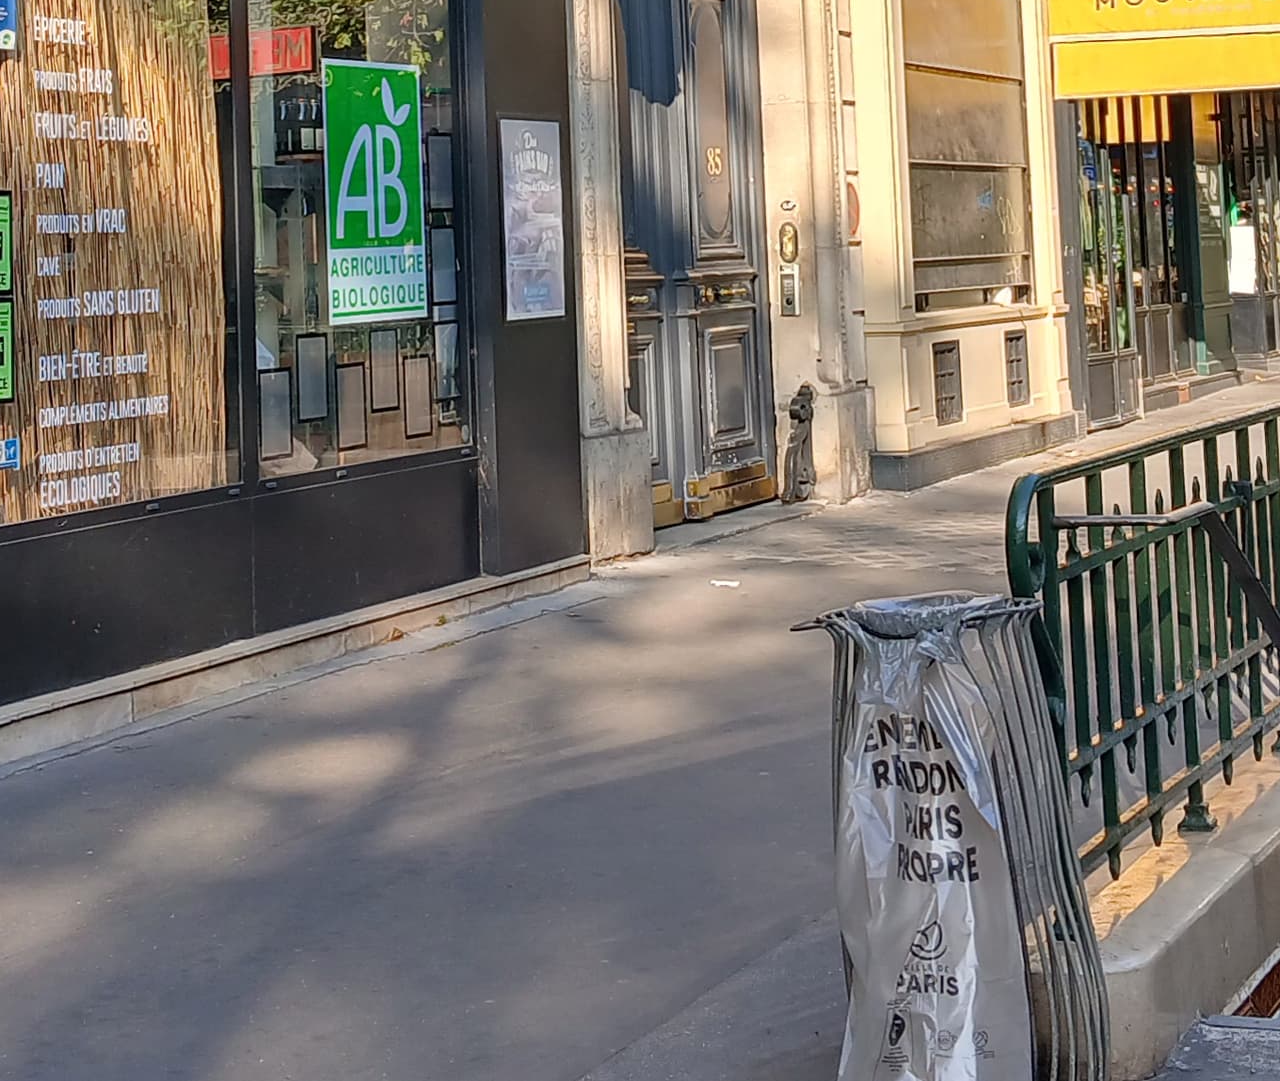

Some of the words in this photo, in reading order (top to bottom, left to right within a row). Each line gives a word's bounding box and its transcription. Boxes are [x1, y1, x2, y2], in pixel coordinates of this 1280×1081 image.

[33, 14, 86, 46] ÉPICERIE
[35, 70, 77, 93] PRODUITS
[79, 68, 113, 95] FRAIS
[35, 112, 77, 140] FRUITS
[80, 121, 91, 139] ET
[95, 113, 149, 142] LÉGUMES
[706, 147, 722, 175] 85
[36, 163, 65, 189] PAIN
[336, 123, 409, 240] AB
[37, 213, 80, 234] PRODUITS
[82, 214, 94, 233] EN
[95, 209, 126, 234] VRAC
[37, 255, 61, 277] CAVE
[330, 253, 424, 278] AGRICULTURE
[38, 298, 80, 320] PRODUITS
[83, 290, 115, 316] SANS
[118, 288, 160, 315] GLUTEN
[332, 283, 425, 309] BIOLOGIQUE
[39, 349, 101, 382] BIEN-ÊTRE
[103, 356, 113, 376] ET
[116, 349, 148, 375] BEAUTÉ
[40, 402, 107, 428] COMPLÉMENTS
[108, 395, 169, 421] ALIMENTAIRES
[40, 450, 83, 474] PRODUITS
[85, 442, 139, 468] D'ENTRETIEN
[40, 471, 121, 508] ÉCOLOGIQUES
[895, 973, 959, 996] PARIS
